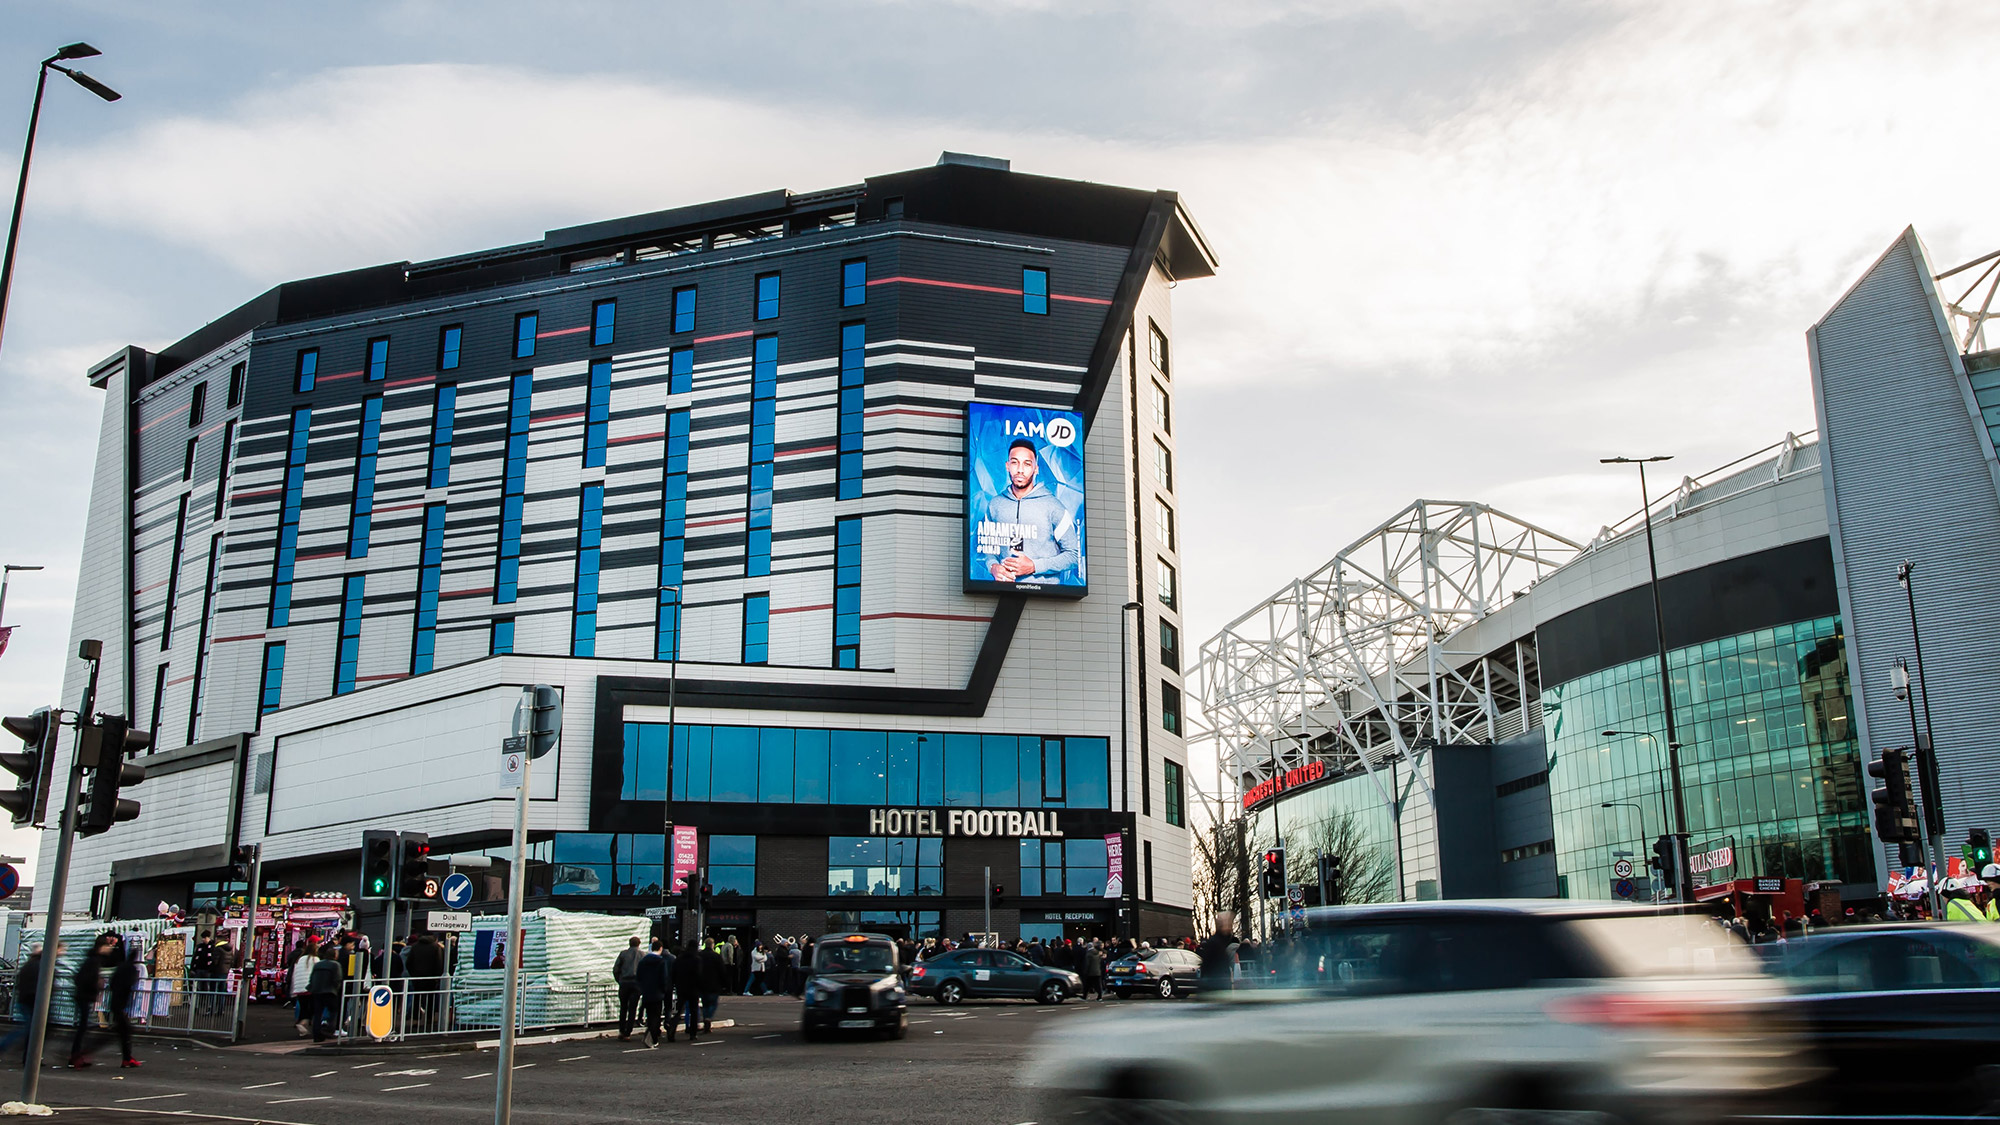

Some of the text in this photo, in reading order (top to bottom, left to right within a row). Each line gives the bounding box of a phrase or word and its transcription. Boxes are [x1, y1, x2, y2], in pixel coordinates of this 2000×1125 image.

[1005, 419, 1072, 440] I AM JD
[977, 521, 1038, 540] AUBAMEYANG
[977, 536, 1011, 546] FOOTBALLER
[1243, 760, 1324, 809] MANCHESTR UNITED
[869, 808, 1064, 837] HOTEL FOOTBALL
[1108, 843, 1123, 857] HERE
[1617, 864, 1630, 873] 30
[1290, 891, 1302, 899] 30
[1044, 912, 1095, 920] HOTEL RECEPTION
